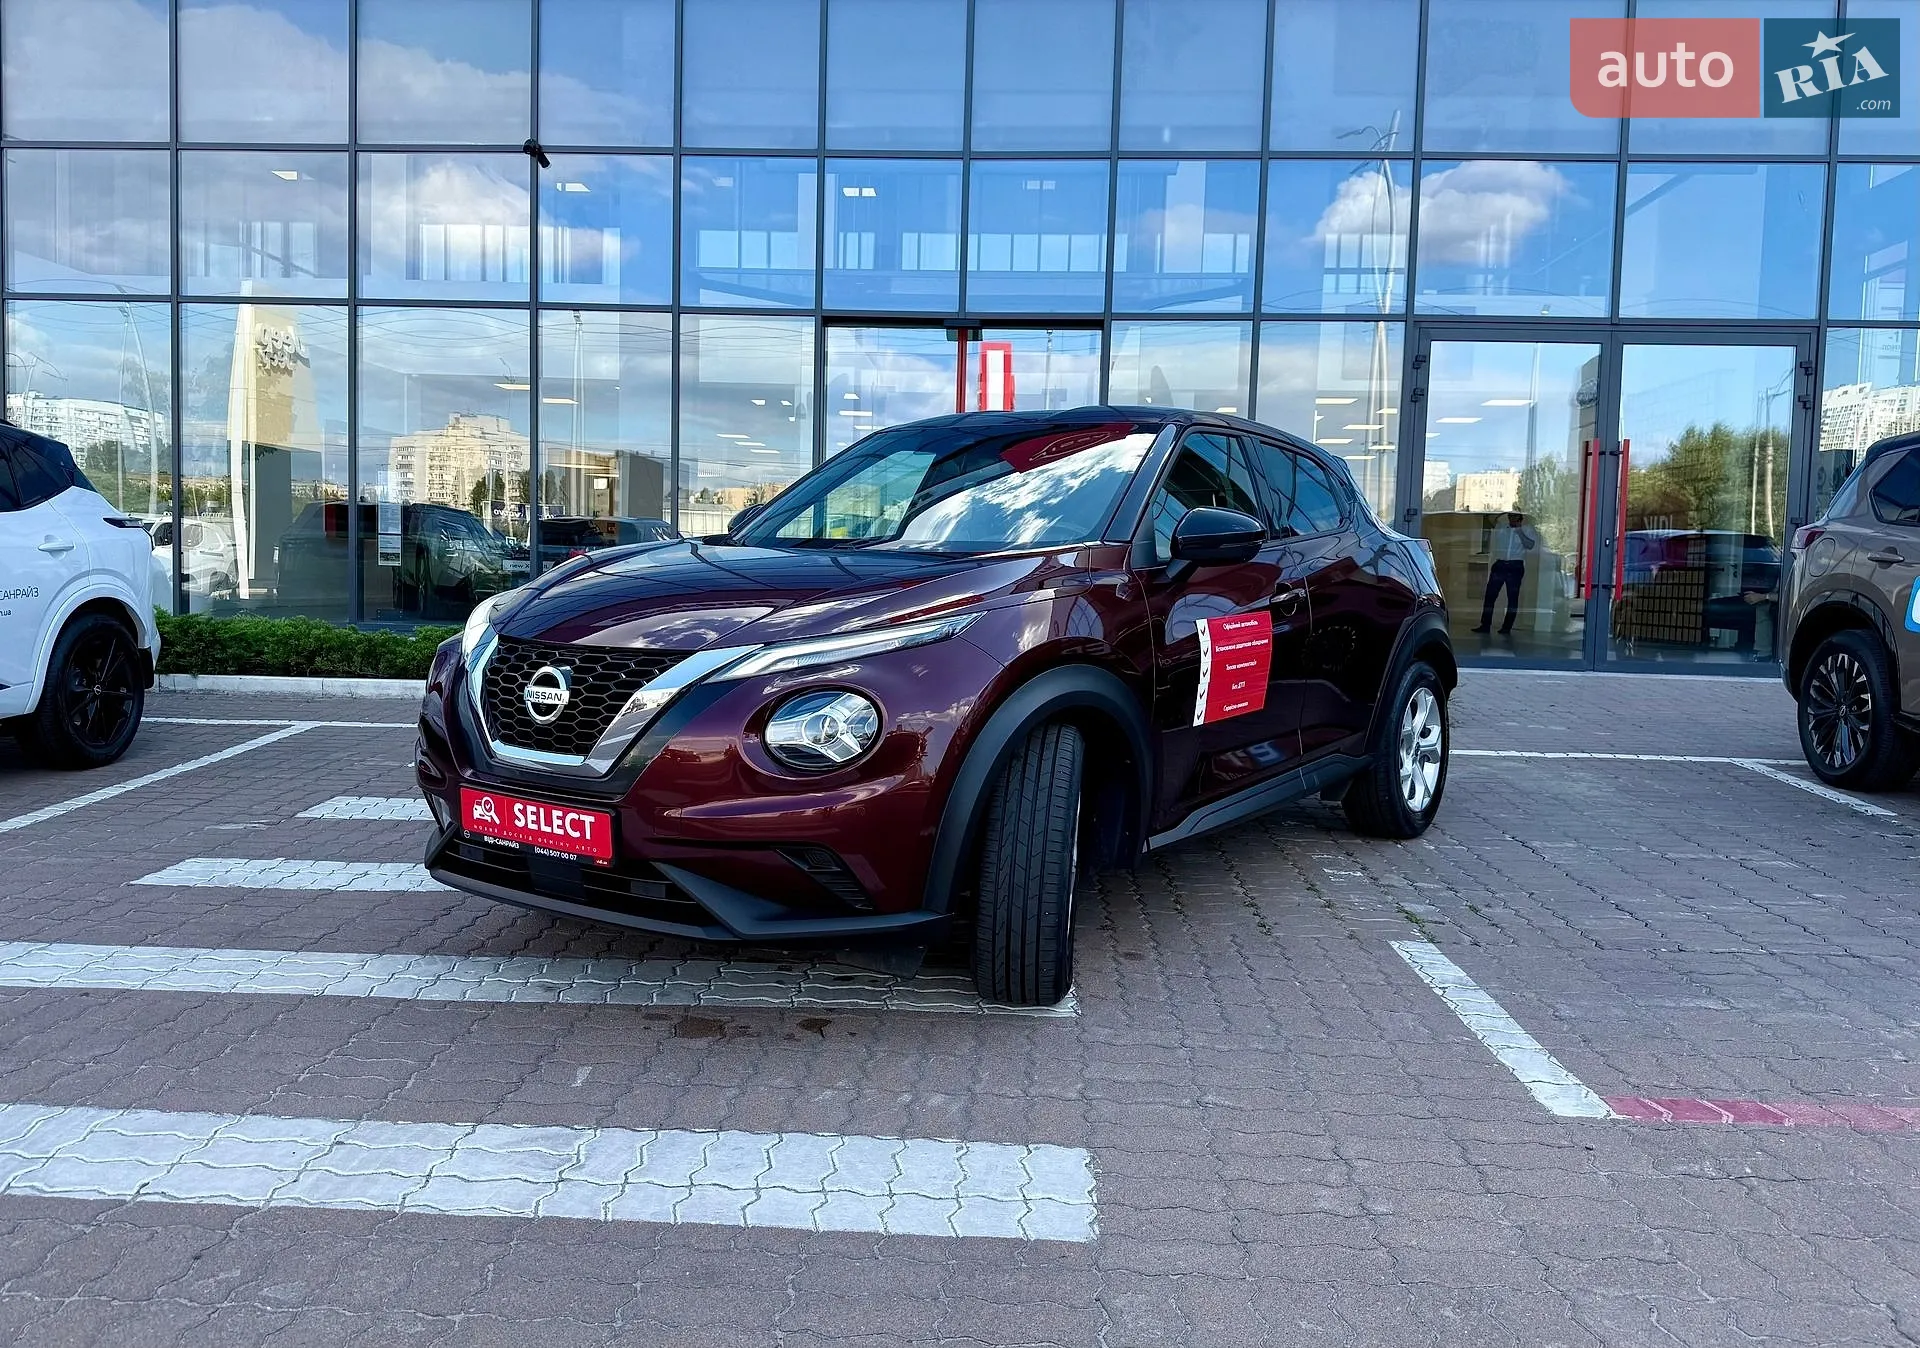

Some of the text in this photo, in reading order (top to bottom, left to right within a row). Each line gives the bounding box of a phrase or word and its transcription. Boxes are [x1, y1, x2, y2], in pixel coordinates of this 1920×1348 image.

[526, 689, 563, 702] NISSAN
[513, 802, 596, 840] SELECT
[575, 844, 597, 853] АВТО
